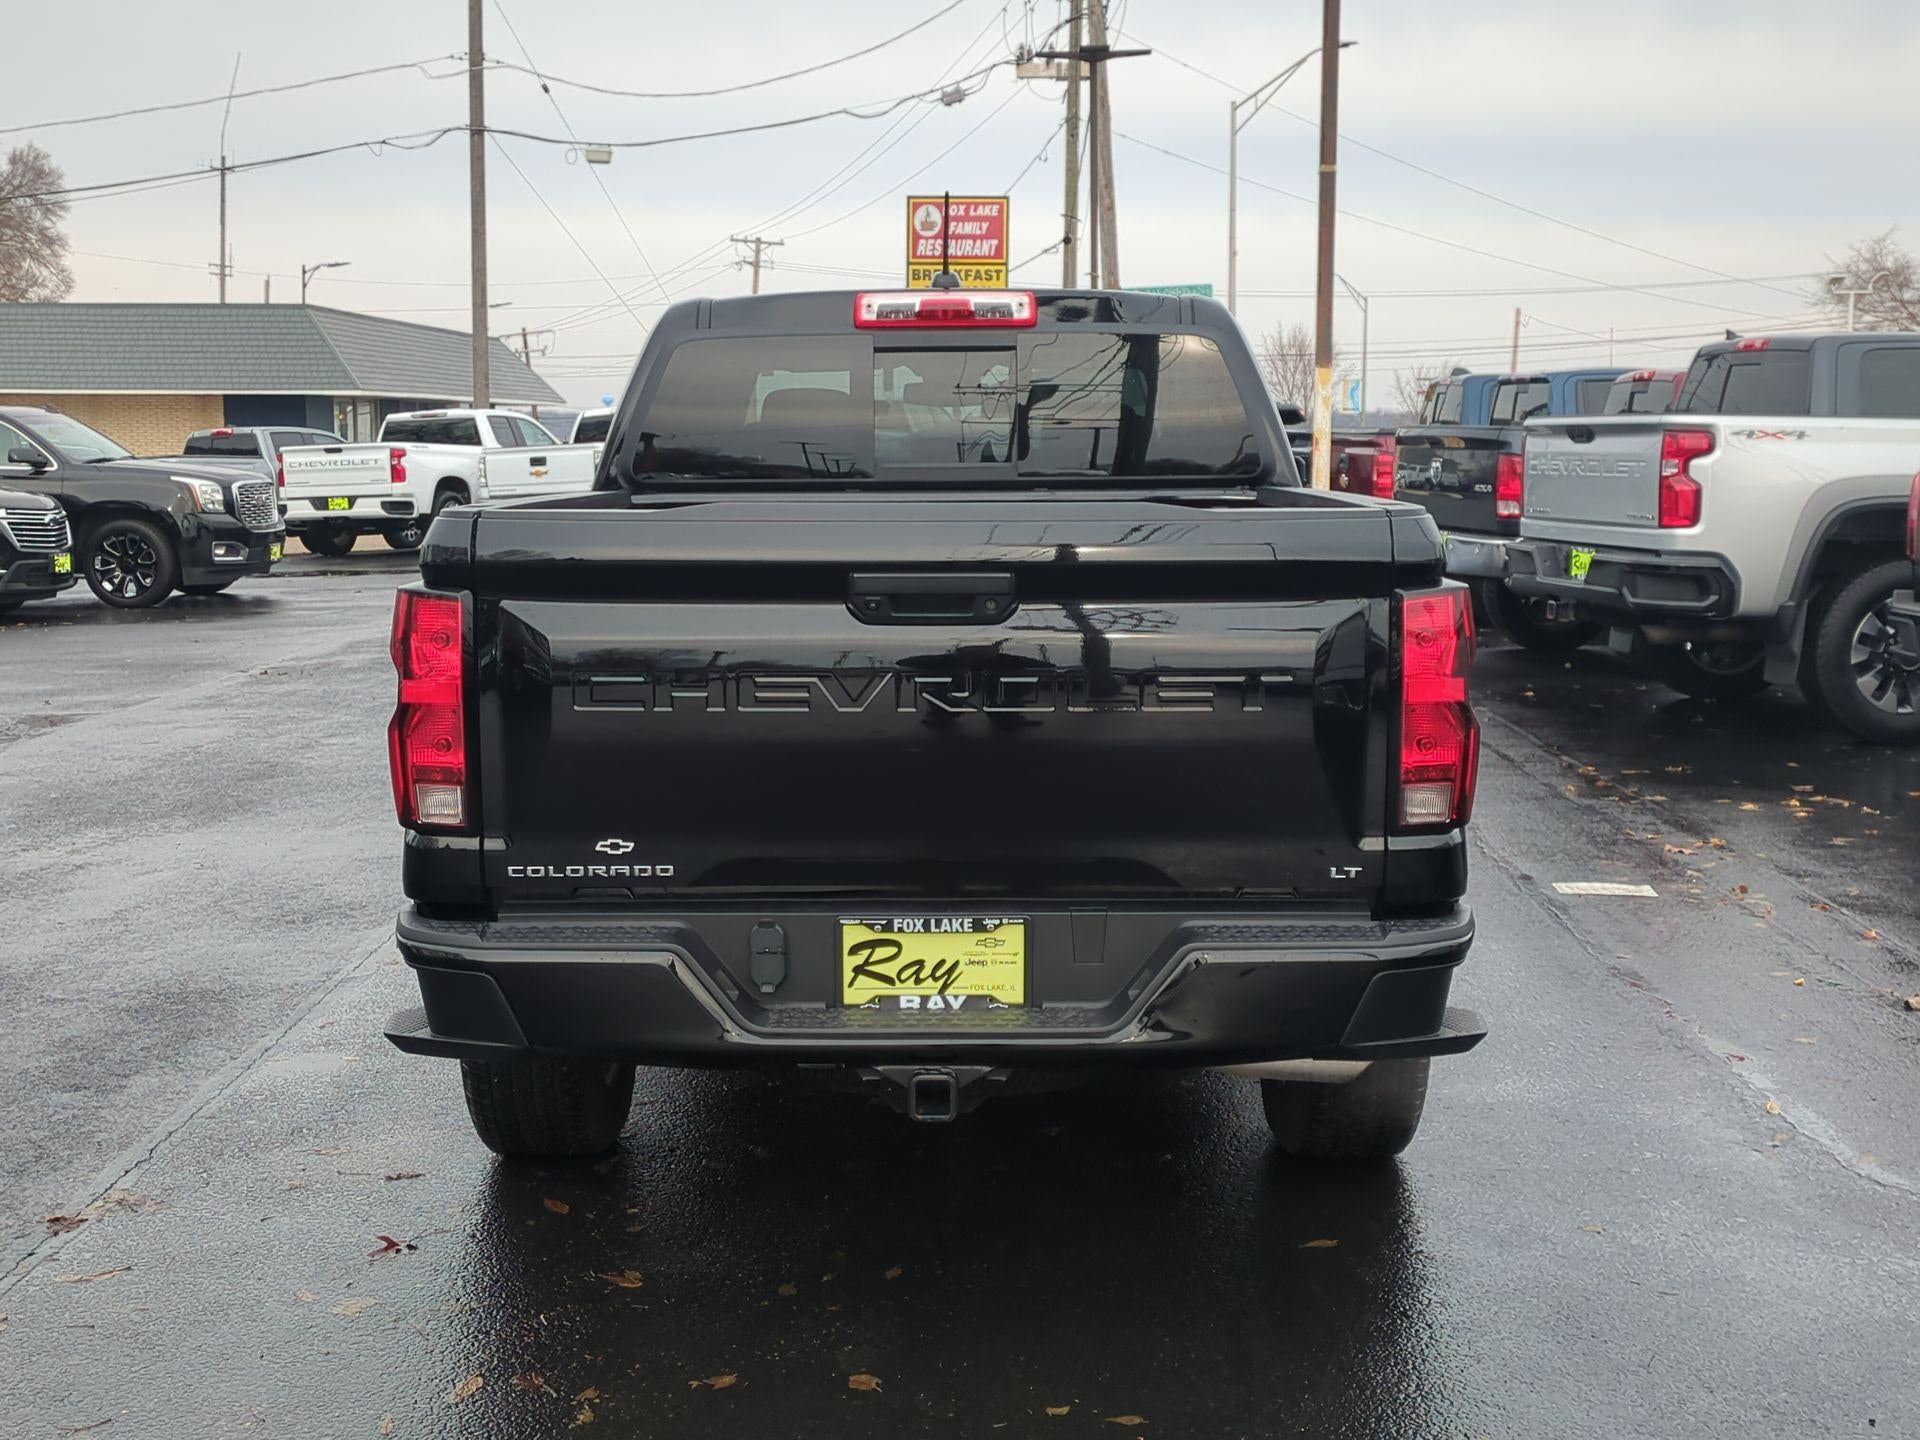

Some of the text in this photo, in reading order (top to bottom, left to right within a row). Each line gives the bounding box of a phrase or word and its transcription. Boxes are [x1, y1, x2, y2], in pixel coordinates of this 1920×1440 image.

[969, 204, 1000, 216] LAKE
[949, 221, 989, 235] FAMILY
[916, 239, 999, 256] RESAURANT
[912, 268, 1003, 281] BRKFAST
[288, 458, 382, 469] CHEVROLET
[1528, 459, 1647, 477] CHEVROLET
[573, 671, 1294, 712] CHEVROLET
[507, 865, 674, 877] COLORADO
[1330, 867, 1363, 878] LT
[893, 918, 973, 933] FOX LAKE
[847, 938, 963, 995] Ray
[965, 958, 988, 967] Jeep
[986, 984, 1009, 992] LAKE,
